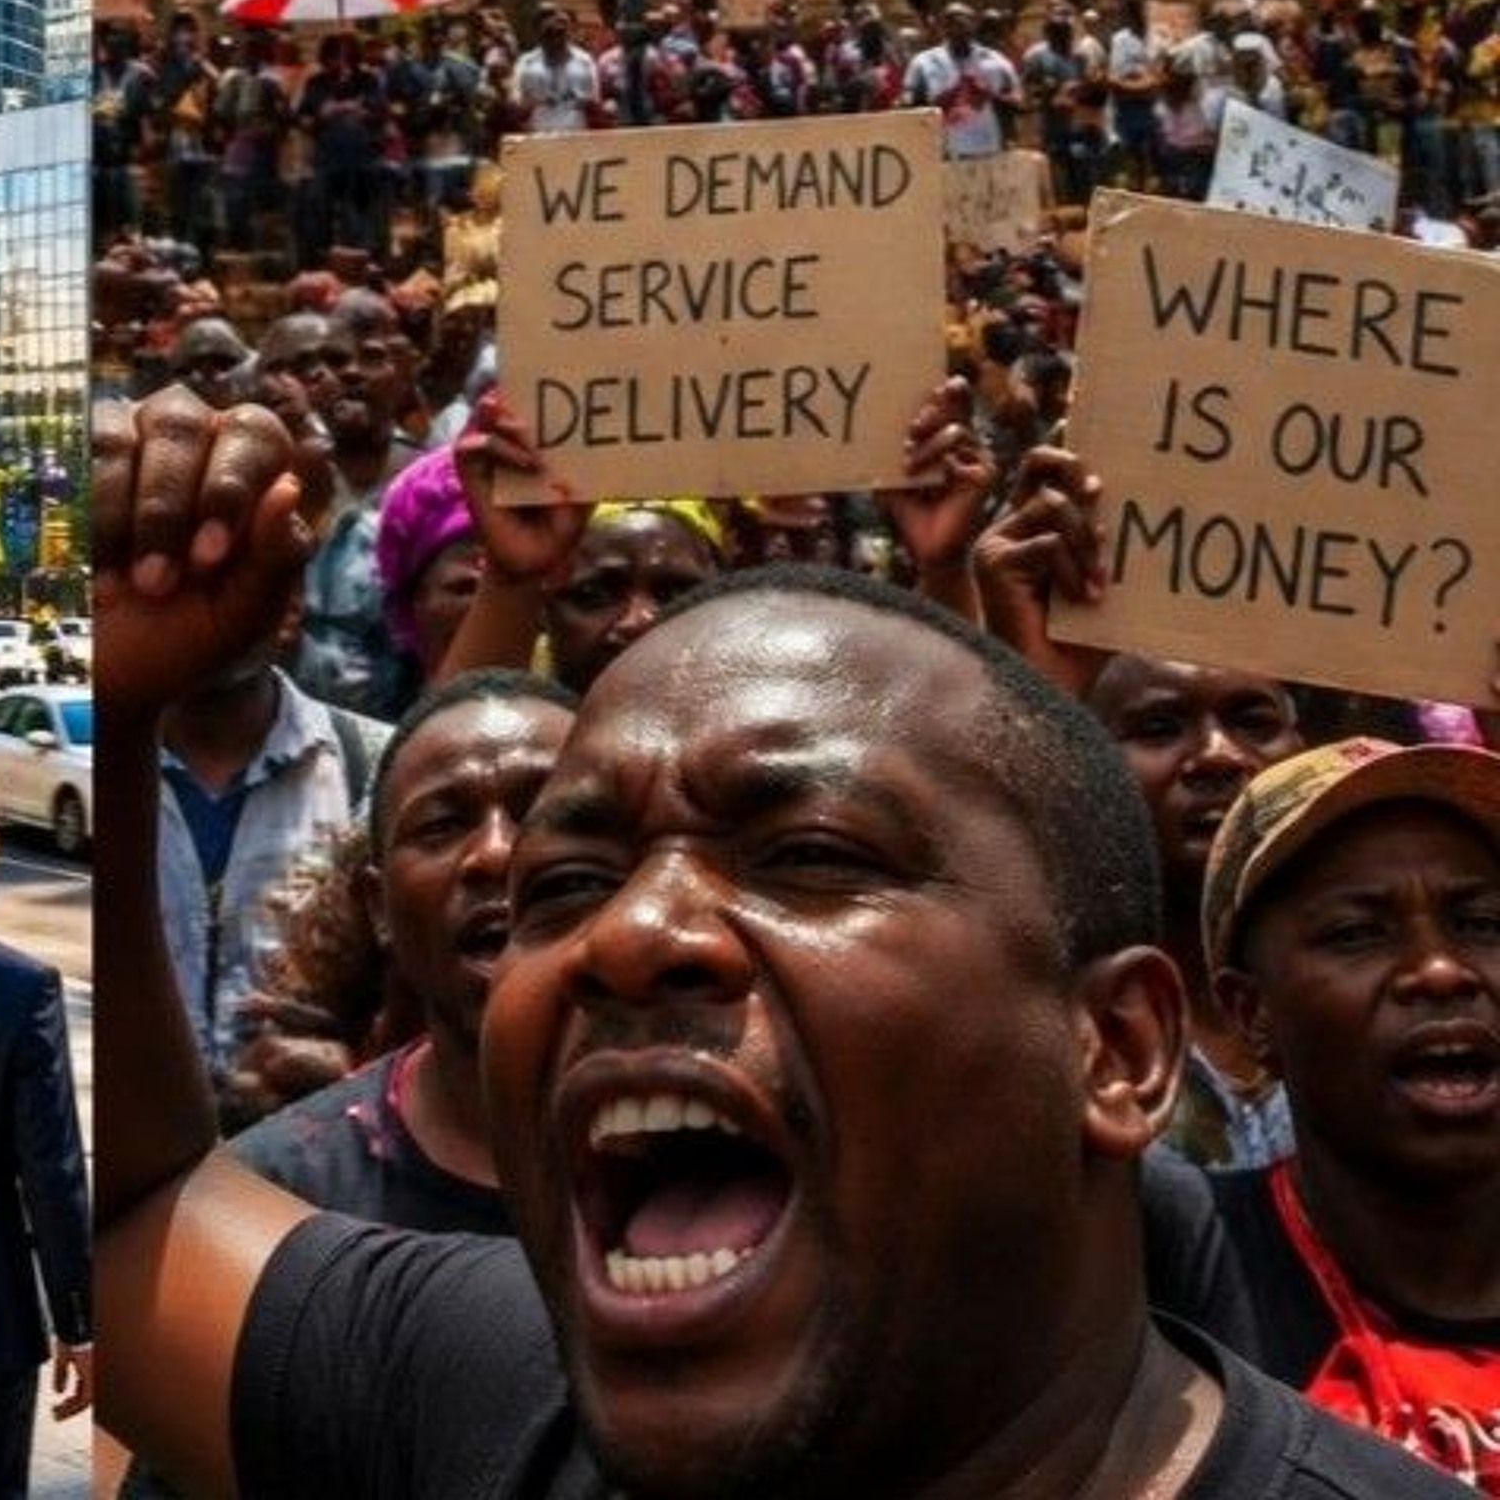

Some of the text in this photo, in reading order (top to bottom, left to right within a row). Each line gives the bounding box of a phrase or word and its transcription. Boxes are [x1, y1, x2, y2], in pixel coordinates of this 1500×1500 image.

[533, 156, 628, 225] WE
[665, 143, 913, 219] DEMAND
[550, 254, 821, 332] SERVICE
[1142, 244, 1463, 378] WHERE
[535, 362, 872, 450] DELIVERY
[1154, 378, 1428, 498] IS OUR
[1109, 498, 1473, 635] MONEY?
